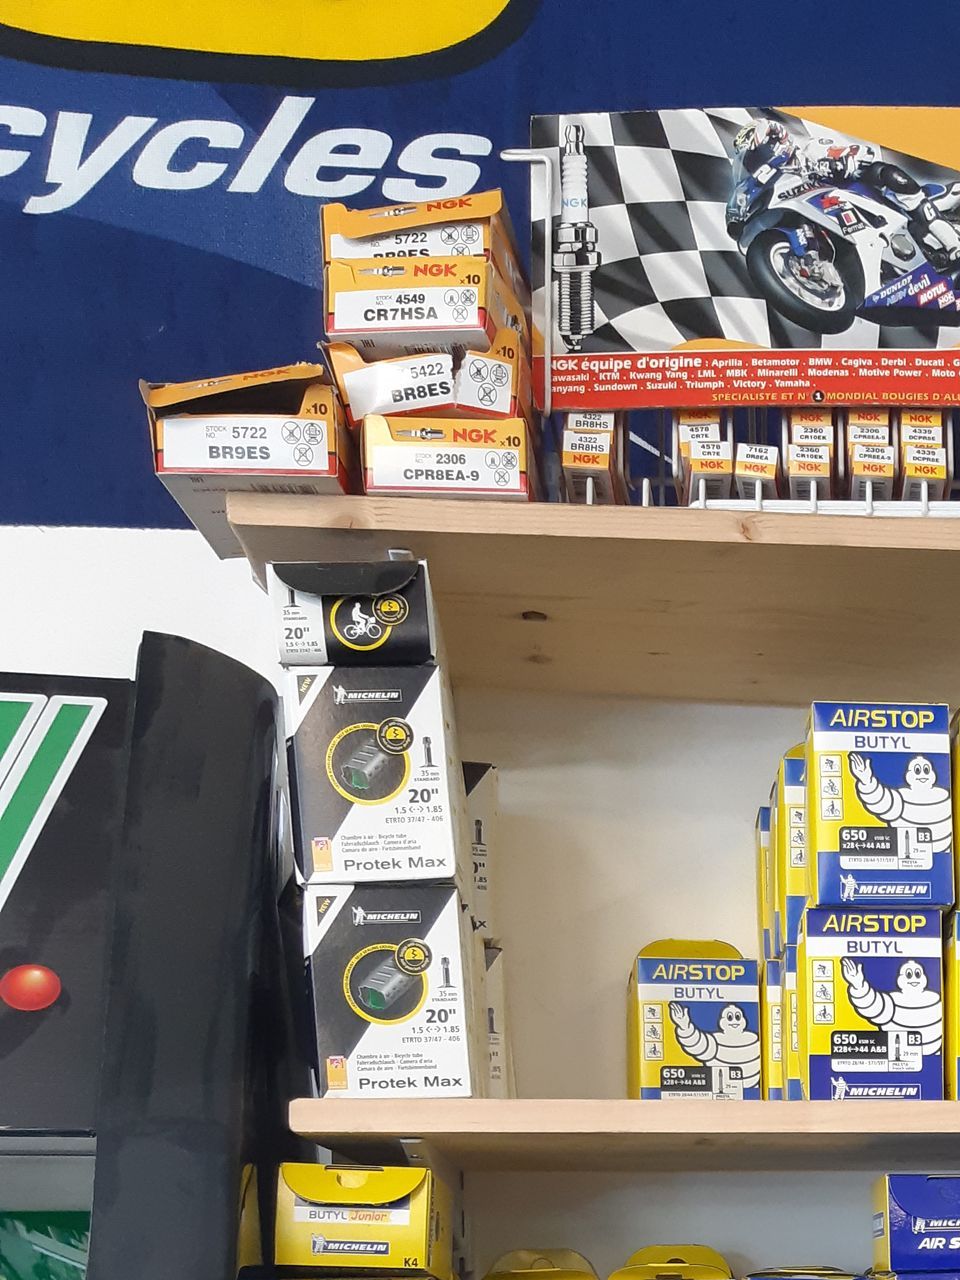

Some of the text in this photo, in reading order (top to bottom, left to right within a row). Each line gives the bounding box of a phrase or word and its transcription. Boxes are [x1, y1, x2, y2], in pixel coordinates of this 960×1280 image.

[427, 197, 473, 212] NGK
[414, 263, 457, 277] NGK
[395, 294, 426, 305] 4549
[363, 306, 439, 322] CR7HSA
[410, 362, 445, 380] 5422
[581, 357, 631, 372] équipe
[637, 356, 702, 371] d'origine
[711, 358, 742, 367] Aprilia
[751, 357, 800, 366] Betamotor
[808, 357, 833, 366] BMW
[841, 357, 873, 367] Cagiva
[881, 357, 906, 366] Derbi
[915, 357, 945, 366] Ducati
[593, 378, 811, 392] Sundown Suzuki Triumph Victory Yamaha
[391, 383, 451, 403] BR8ES
[827, 392, 879, 401] MONDIAL
[881, 392, 929, 401] BOUGIES
[231, 426, 267, 440] 5722
[453, 429, 497, 443] NGK
[208, 445, 271, 461] BR9ES
[570, 443, 605, 452] BR8HS
[435, 453, 467, 465] 2306
[573, 454, 600, 464] NGK
[403, 468, 480, 483] CPR8EA-9
[284, 627, 310, 640] 20"
[347, 690, 399, 699] MICHELIN
[829, 708, 935, 729] AIRSTOP
[854, 735, 911, 749] BUTYL
[408, 788, 439, 803] 20"
[842, 829, 867, 841] 650
[917, 832, 931, 843] B3
[343, 857, 447, 872] Protek Max
[859, 884, 928, 895] MICHELIN
[822, 914, 927, 933] AIRSTOP
[847, 939, 903, 954] BUTYL
[652, 963, 745, 982] AIRSTOP
[674, 986, 725, 1000] BUTYL
[425, 1009, 456, 1023] 20"
[359, 1075, 463, 1090] Protek Max
[308, 1210, 387, 1222] BUTYL Junior
[325, 1242, 387, 1252] MICHELIN
[918, 1237, 944, 1249] AIR
[403, 1257, 419, 1268] K4
